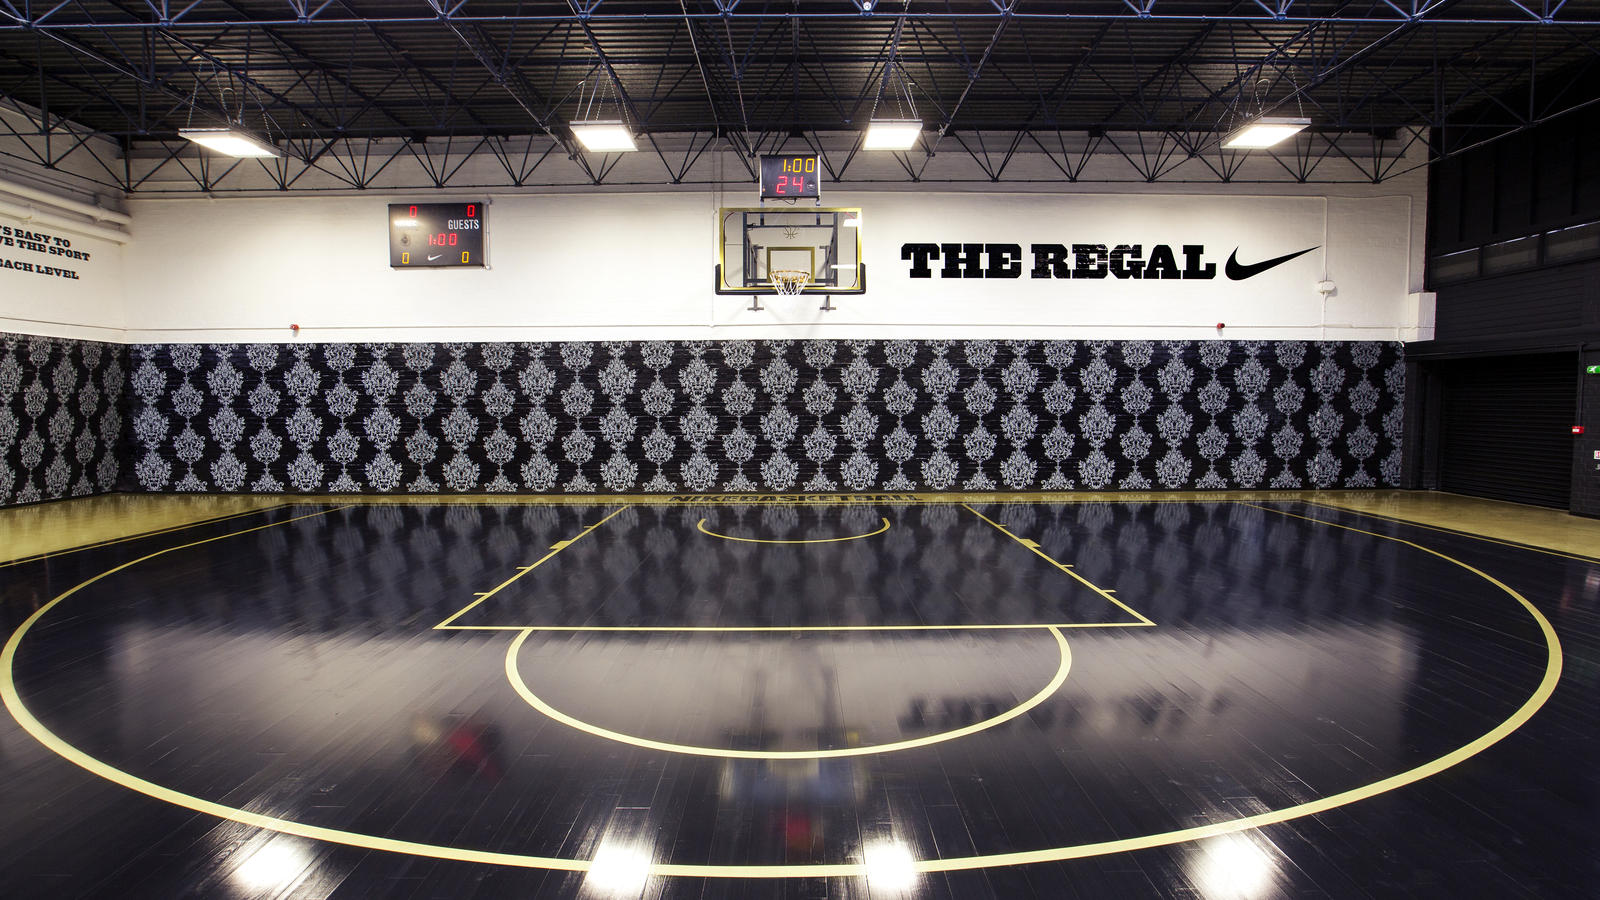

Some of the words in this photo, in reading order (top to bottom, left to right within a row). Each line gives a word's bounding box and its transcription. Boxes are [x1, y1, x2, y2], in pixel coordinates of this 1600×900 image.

[783, 158, 815, 173] 1:00
[776, 175, 804, 194] 24
[409, 206, 417, 218] 0
[467, 205, 475, 217] 0
[448, 219, 480, 230] GUESTS
[14, 228, 51, 244] EASY
[53, 236, 71, 248] TO
[428, 233, 457, 246] 1:00
[16, 239, 47, 253] THE
[48, 246, 90, 261] SPORT
[402, 252, 410, 264] 0
[461, 251, 469, 263] 0
[901, 243, 1022, 279] THE
[1031, 243, 1217, 280] REGAL
[36, 265, 79, 280] LEVEL
